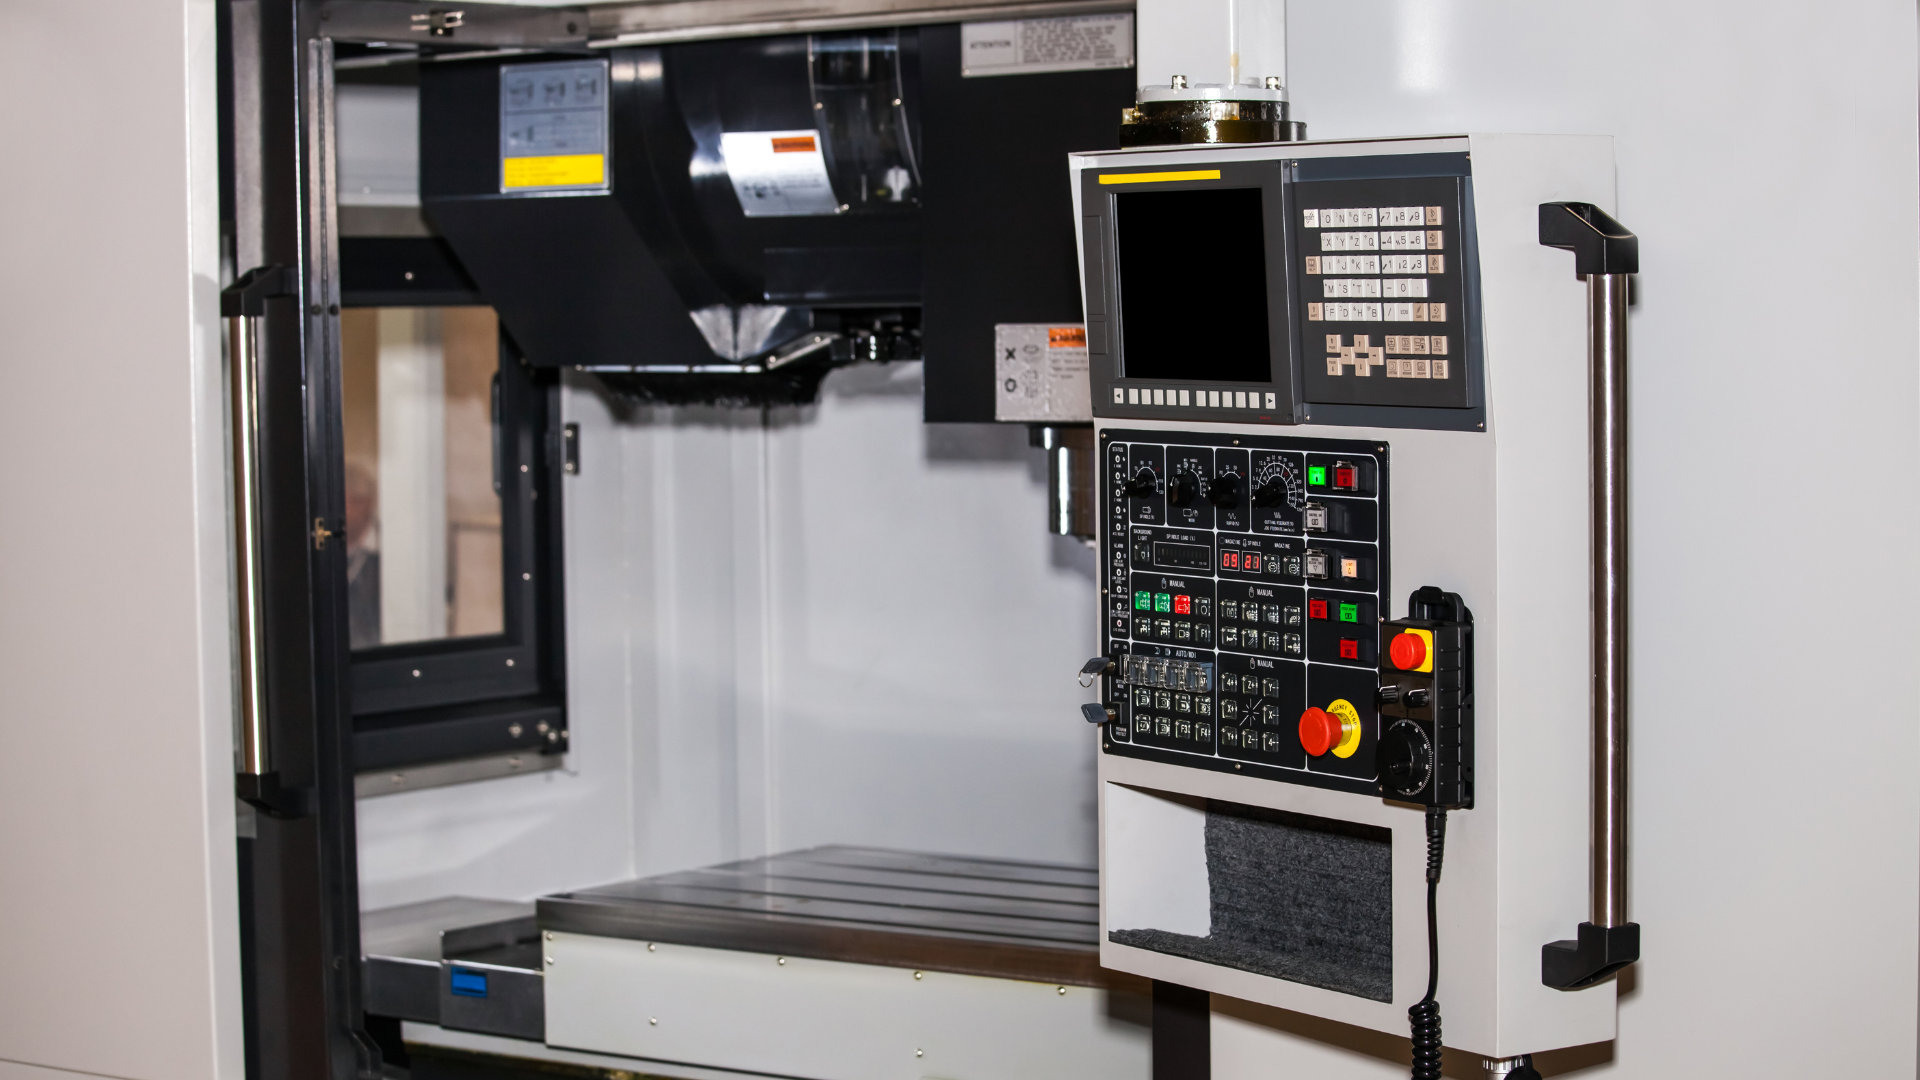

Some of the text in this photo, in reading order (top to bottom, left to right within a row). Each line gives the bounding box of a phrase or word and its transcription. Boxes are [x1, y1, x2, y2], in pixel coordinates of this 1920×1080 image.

[970, 40, 1011, 49] ATTENTION
[1223, 553, 1238, 567] 09
[1244, 555, 1259, 569] 21
[1257, 589, 1273, 597] MANUAL
[1258, 660, 1274, 668] MANUAL
[1349, 710, 1357, 725] STOP
